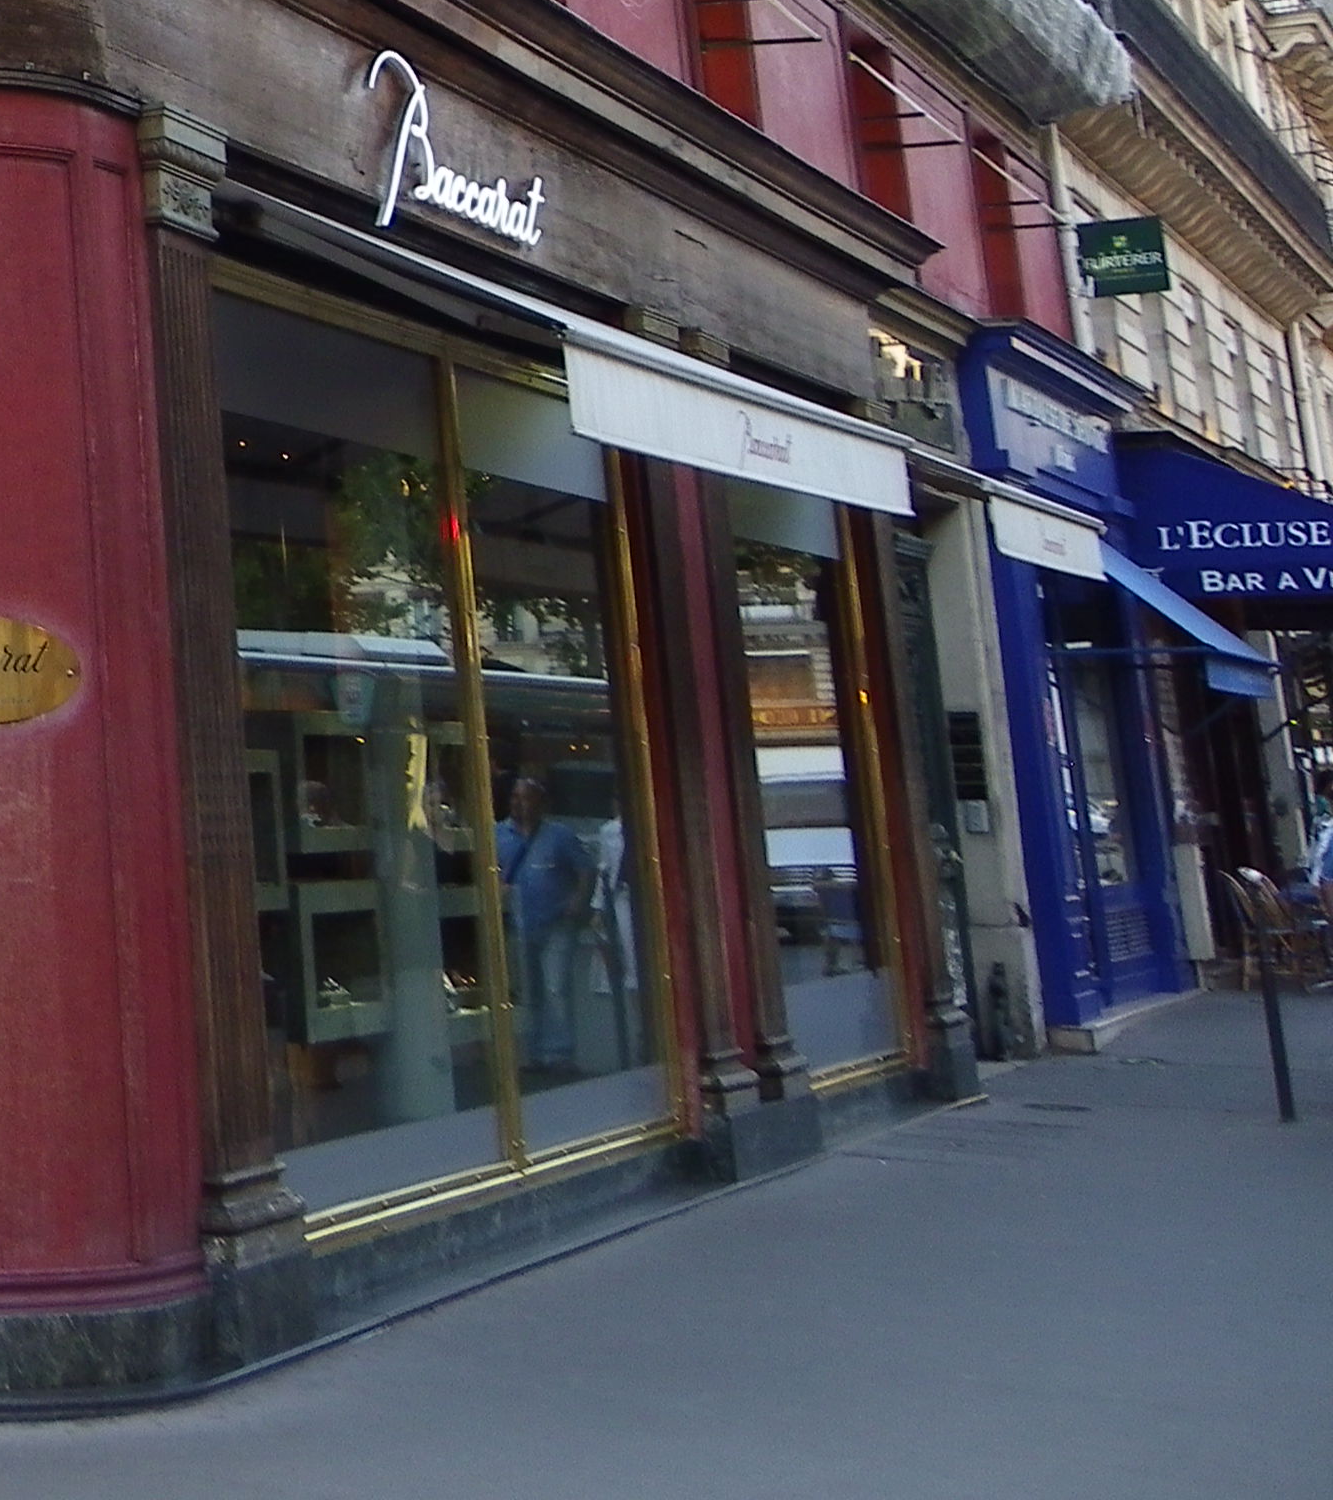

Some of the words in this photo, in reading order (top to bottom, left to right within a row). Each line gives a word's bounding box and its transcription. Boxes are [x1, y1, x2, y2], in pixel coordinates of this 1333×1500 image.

[364, 49, 546, 246] Baccarat
[1156, 520, 1332, 551] L'ECLUSE
[1277, 571, 1300, 591] A
